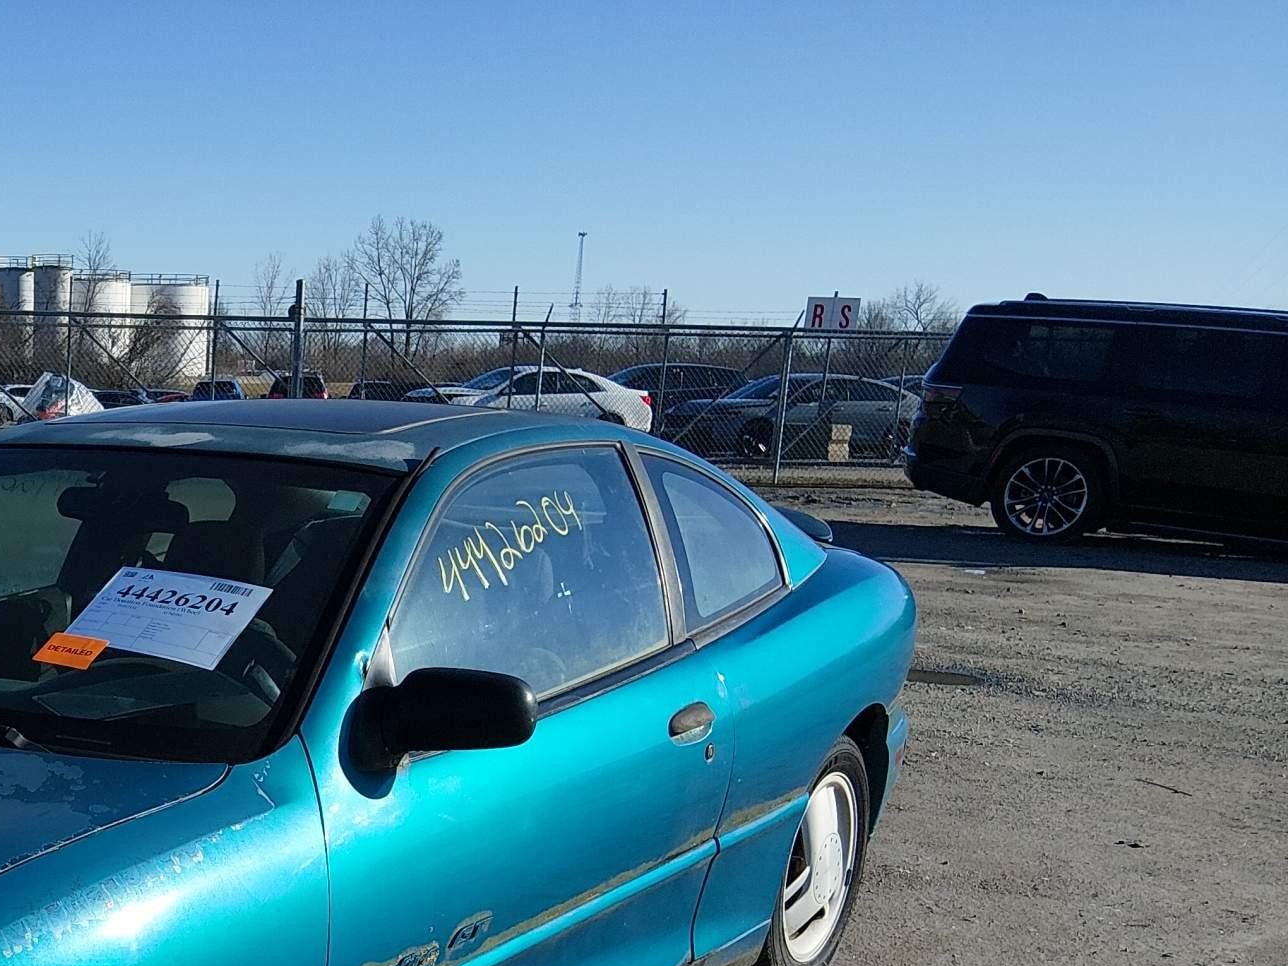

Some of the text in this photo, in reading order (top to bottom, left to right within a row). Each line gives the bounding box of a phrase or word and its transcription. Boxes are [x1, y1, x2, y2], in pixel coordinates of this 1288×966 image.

[810, 303, 852, 329] R S
[437, 489, 583, 601] 44426204
[116, 584, 240, 616] 44426204
[47, 644, 93, 657] DETAILED
